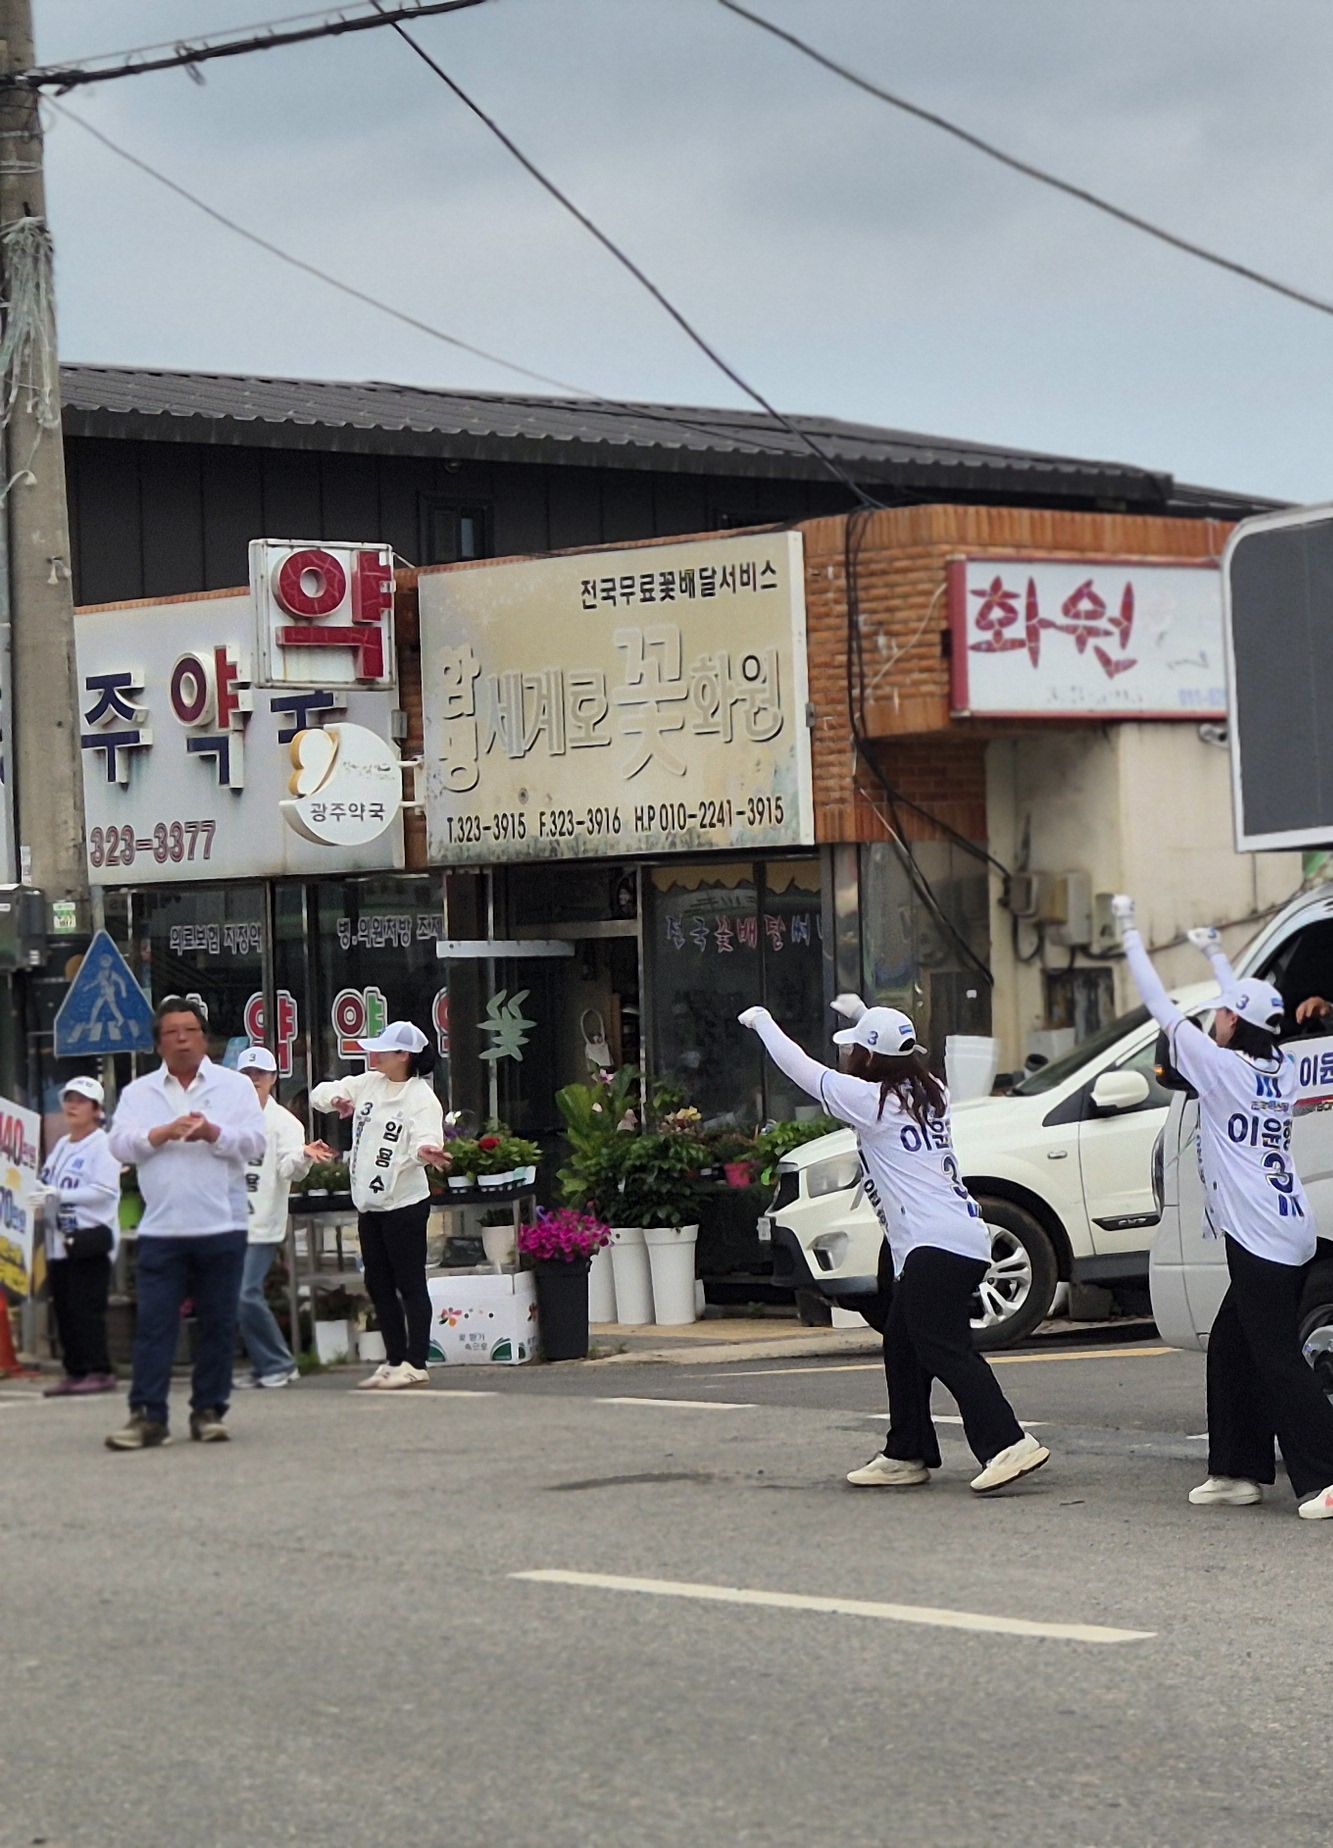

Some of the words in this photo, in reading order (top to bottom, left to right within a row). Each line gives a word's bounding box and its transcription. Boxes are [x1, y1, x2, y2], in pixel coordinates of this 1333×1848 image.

[276, 549, 394, 680] 약
[968, 575, 1138, 679] 화원
[310, 802, 386, 823] 광주약국
[447, 815, 527, 844] T.323-3915
[538, 806, 621, 836] F.323-3916
[90, 819, 216, 868] 323-3377
[1236, 995, 1250, 1010] 3
[868, 1031, 878, 1046] 3
[361, 1102, 373, 1116] 3
